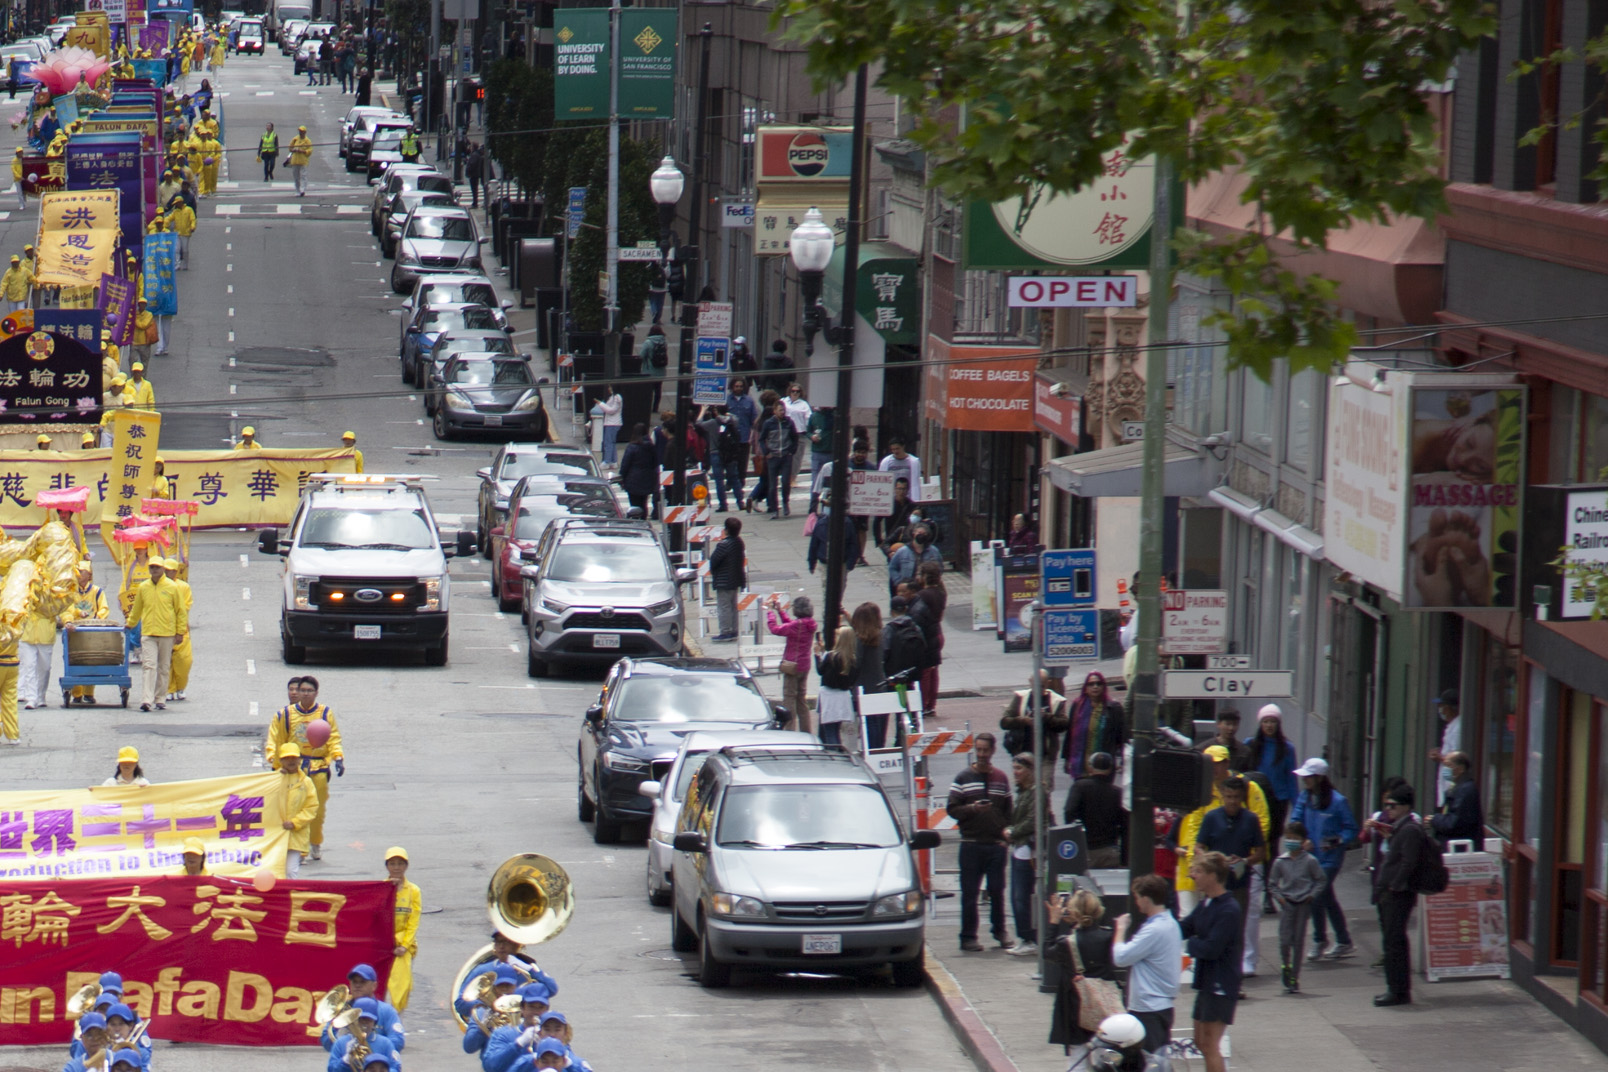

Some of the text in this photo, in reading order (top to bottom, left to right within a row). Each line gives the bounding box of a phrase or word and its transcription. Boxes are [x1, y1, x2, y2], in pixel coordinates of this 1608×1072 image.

[558, 43, 605, 54] UNIVERSITY
[558, 54, 595, 64] OF LEARN
[558, 65, 597, 75] BY DOING.
[789, 150, 828, 160] PEPSI
[1019, 281, 1127, 302] OPEN
[872, 271, 904, 332] 寶馬
[987, 370, 1030, 381] BAGELS
[15, 396, 70, 408] Falun Gong
[967, 398, 1029, 410] CHOCOLATE
[866, 475, 892, 484] PARKING
[1413, 483, 1517, 507] MASSAGE
[1046, 556, 1093, 569] Pay here
[1012, 592, 1032, 600] SCAN
[1167, 592, 1225, 608] NO PARKING
[1048, 614, 1083, 625] Pay by
[1048, 624, 1085, 633] License
[1048, 634, 1074, 643] Plate
[1212, 657, 1237, 667] 700
[1204, 676, 1254, 695] Clay
[119, 854, 140, 871] to
[208, 849, 262, 867] ublic
